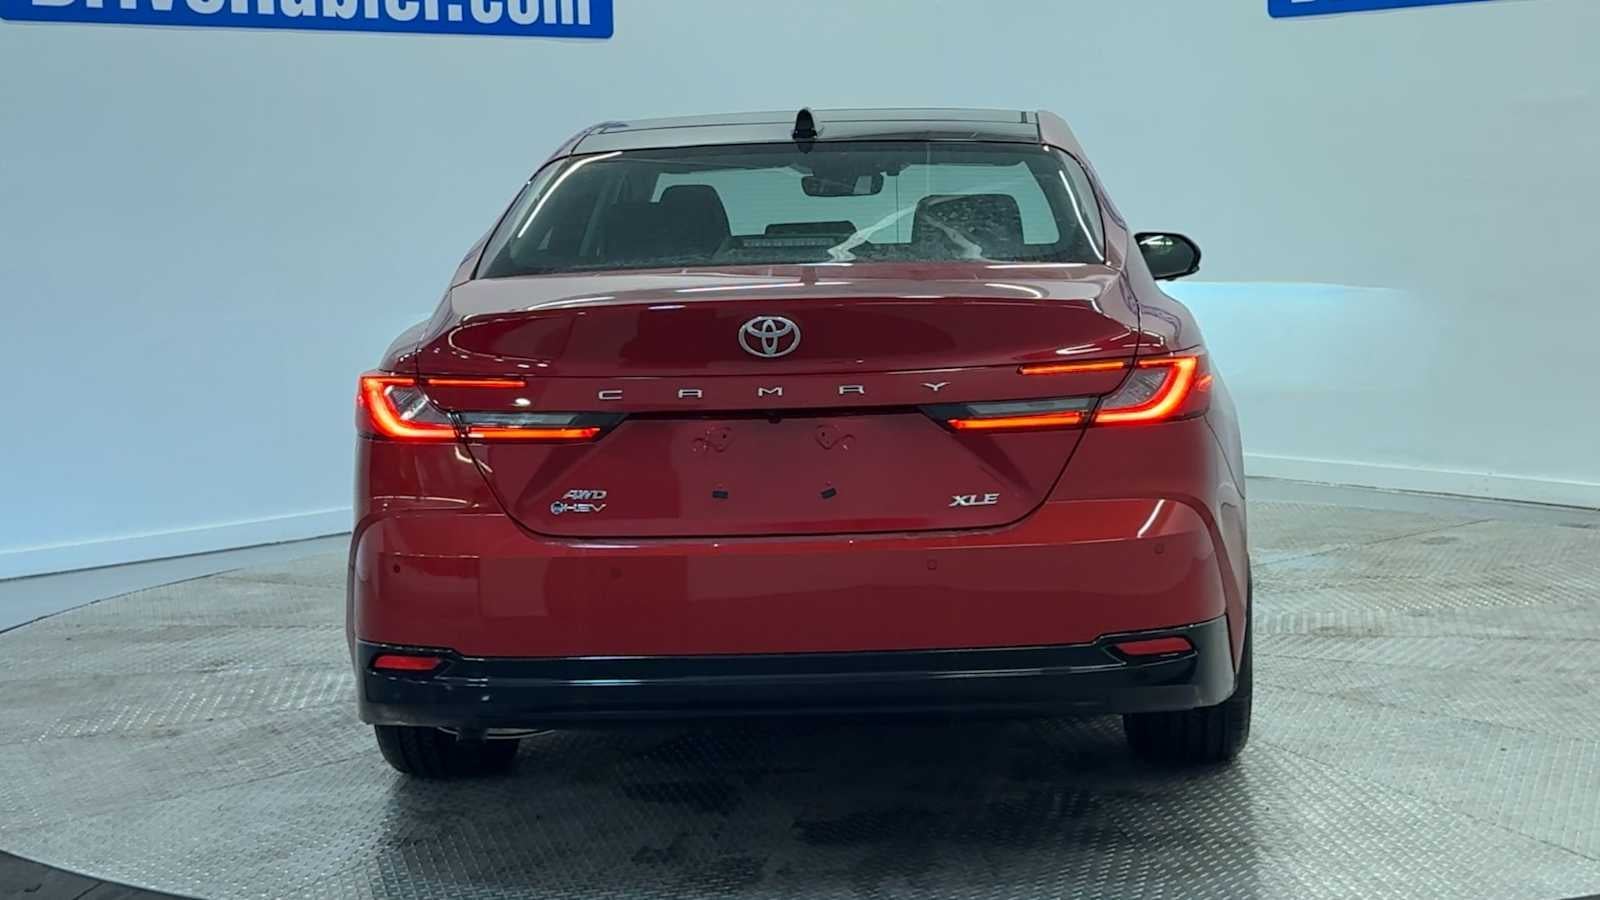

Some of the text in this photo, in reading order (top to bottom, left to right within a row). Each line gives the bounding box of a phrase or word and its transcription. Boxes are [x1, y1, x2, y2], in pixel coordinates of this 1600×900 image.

[598, 382, 949, 400] CAMRY
[562, 489, 608, 500] AWD
[949, 493, 1000, 507] XLE
